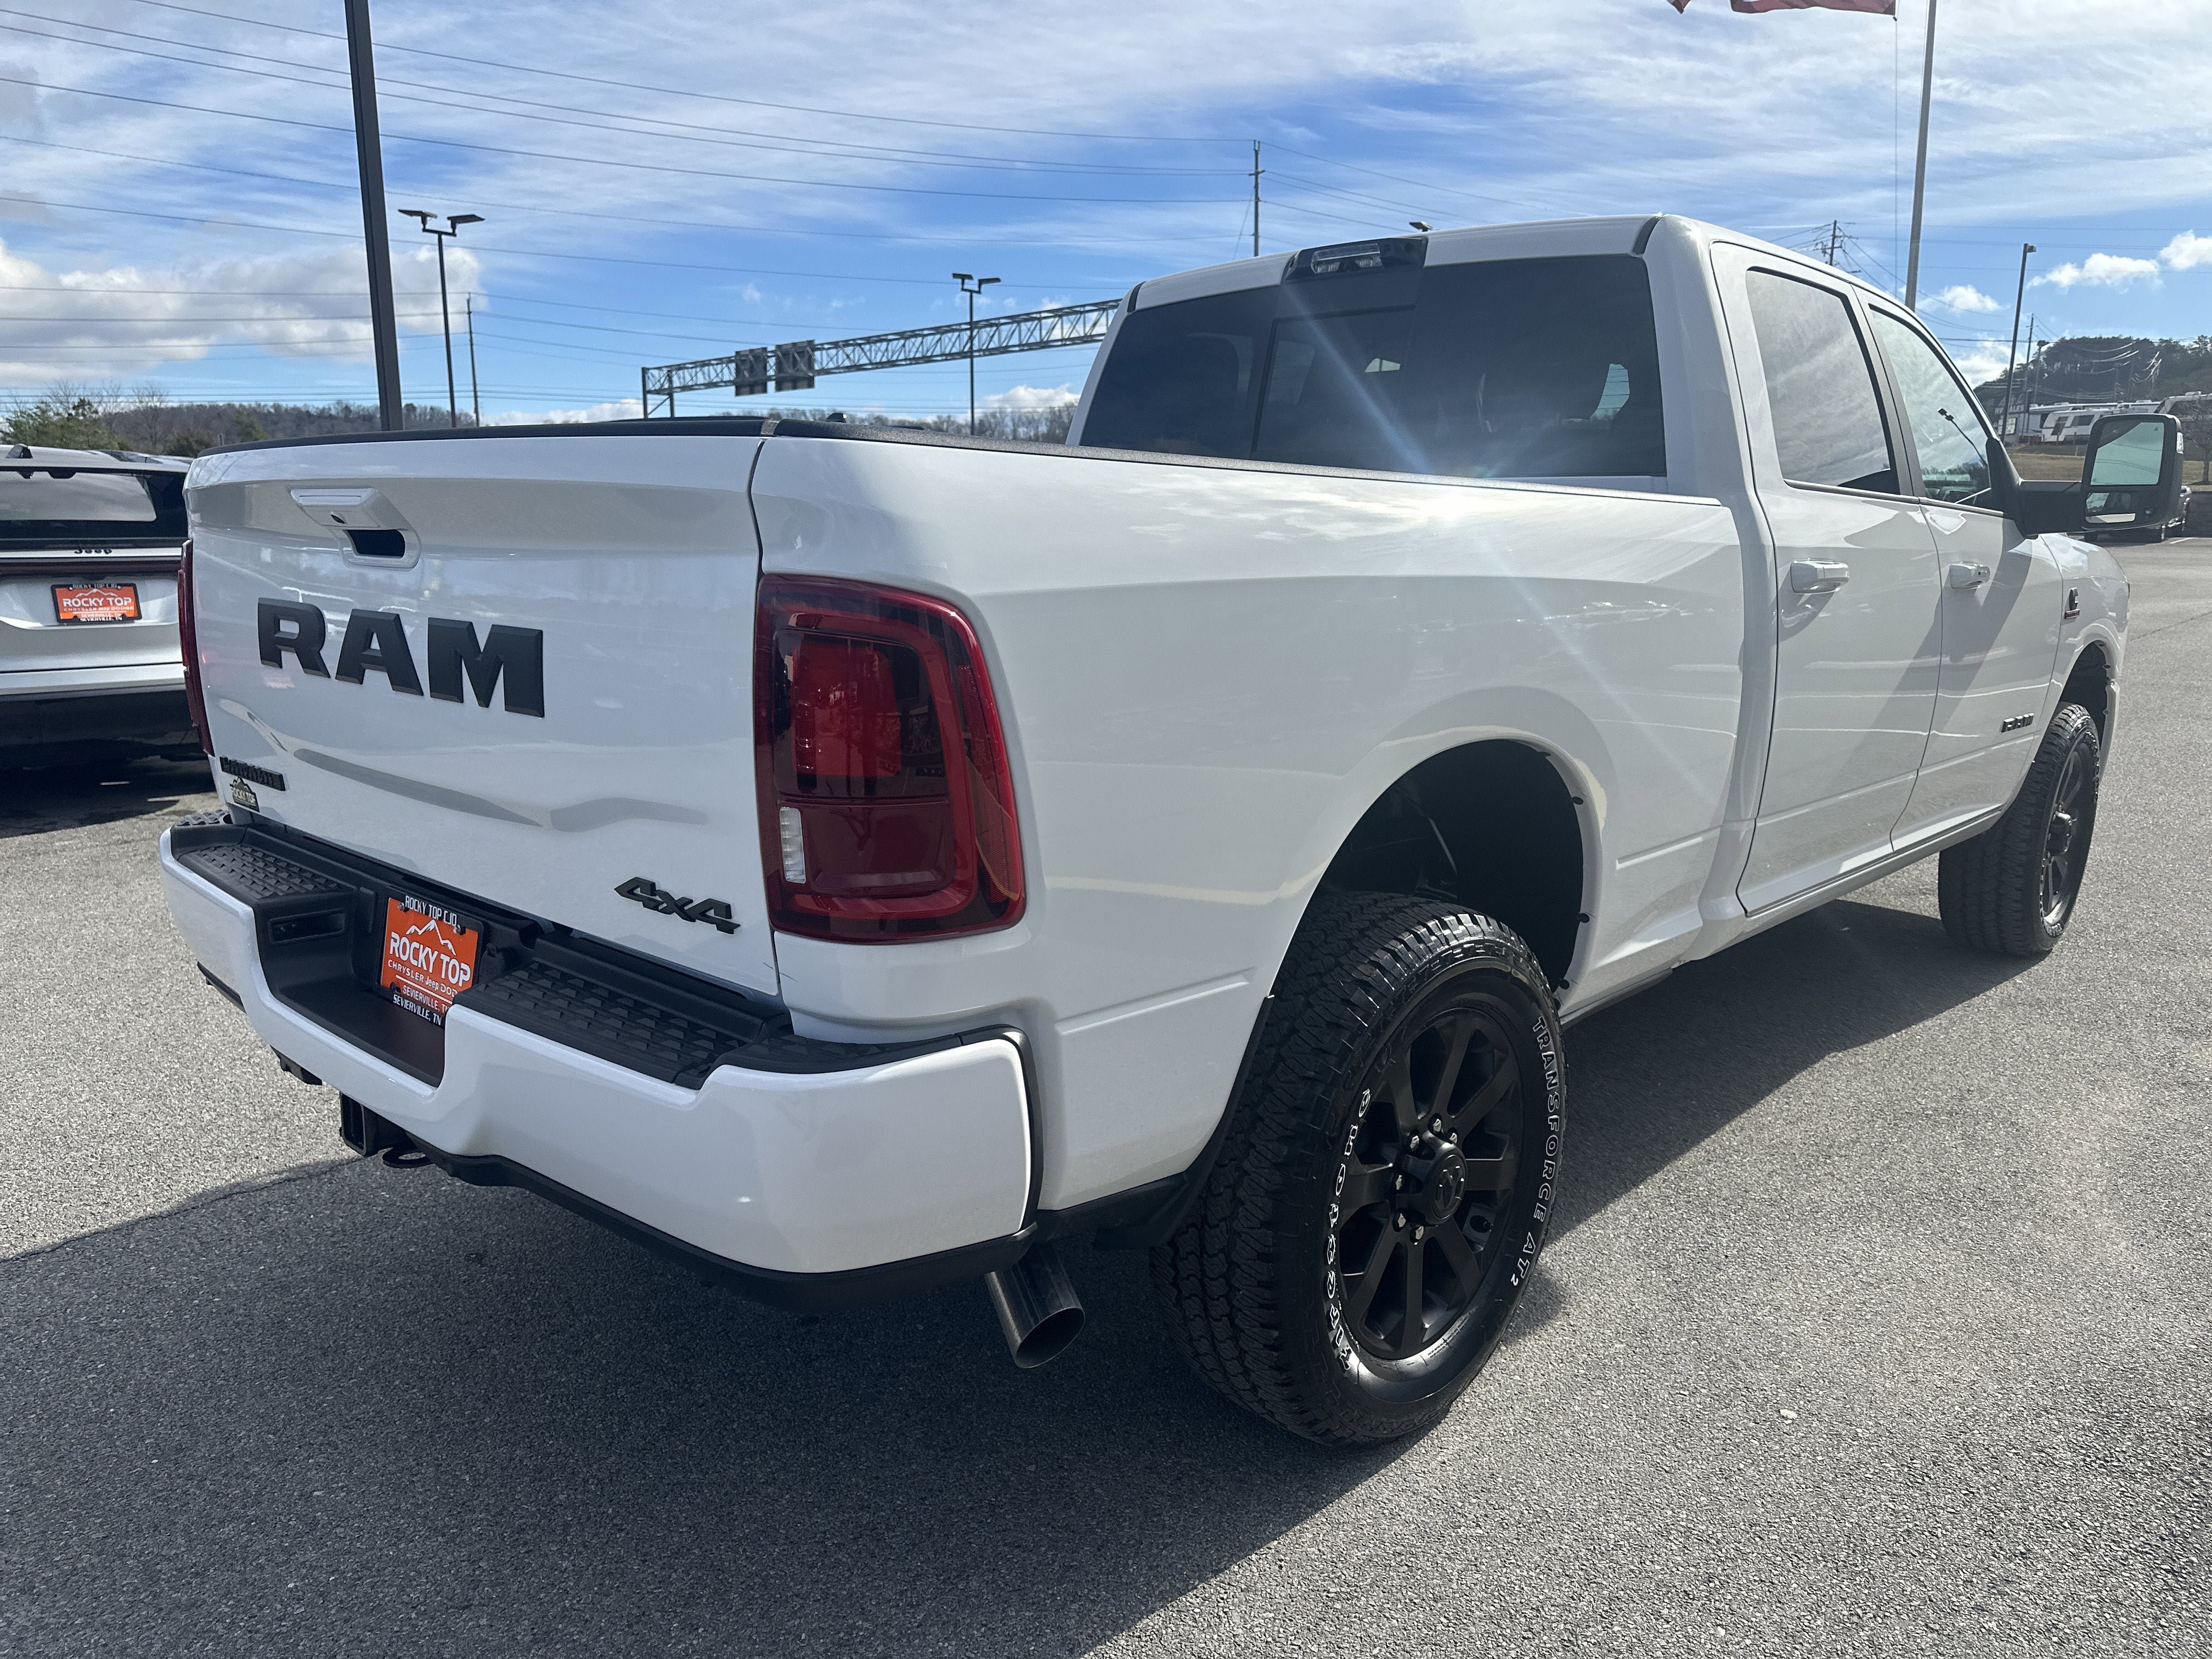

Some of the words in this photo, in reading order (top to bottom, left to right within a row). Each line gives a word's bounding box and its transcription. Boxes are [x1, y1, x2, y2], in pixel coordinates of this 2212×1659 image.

[63, 597, 104, 607] ROCKY
[106, 596, 132, 606] TOP
[258, 597, 545, 718] RAM
[2001, 713, 2034, 733] RAM
[405, 895, 427, 916] ROCKY
[428, 904, 442, 921] TOP
[390, 932, 438, 973] ROCKY
[440, 953, 471, 987] TOP
[388, 960, 424, 983] CHRYSLER
[425, 975, 439, 991] Jeep
[393, 994, 431, 1022] SEVIERVILLE,
[433, 1013, 442, 1026] TN
[403, 985, 439, 1012] SEVIERVILLE,
[1532, 1016, 1560, 1222] TRANSFORCE
